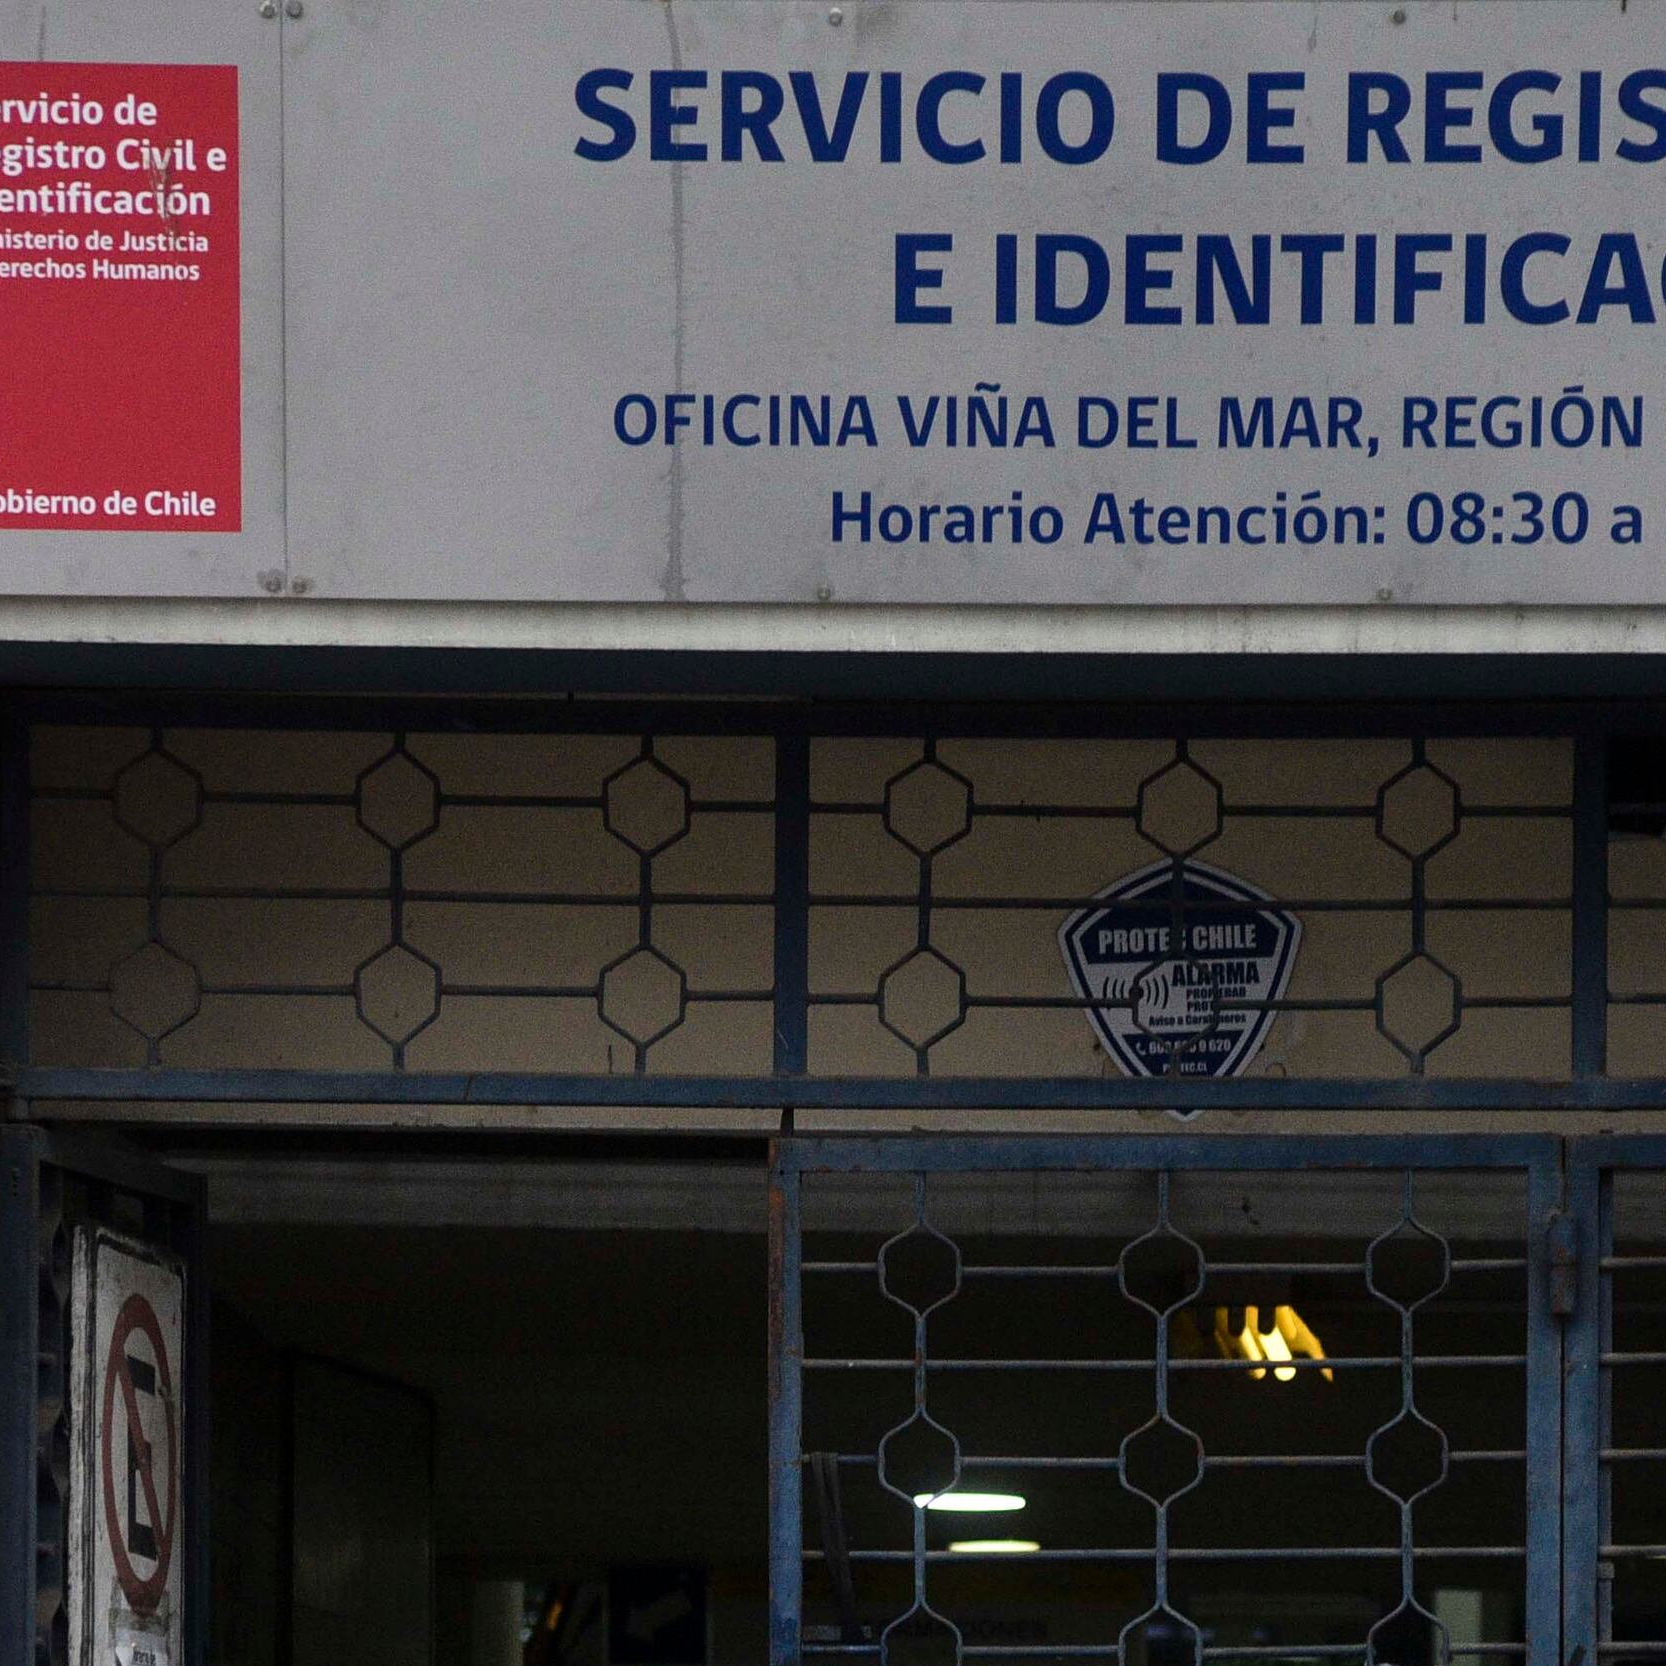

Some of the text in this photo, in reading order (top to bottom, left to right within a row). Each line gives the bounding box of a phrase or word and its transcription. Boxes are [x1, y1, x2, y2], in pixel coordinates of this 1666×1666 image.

[114, 94, 157, 125] de
[574, 69, 1114, 165] SERVICIO
[1157, 72, 1305, 165] DE
[117, 139, 196, 170] Civil
[207, 148, 226, 171] e
[85, 230, 113, 250] de
[120, 231, 208, 252] Justicia
[93, 259, 199, 280] Humanos
[895, 234, 952, 324] E
[614, 394, 878, 446] OFICINA
[897, 382, 1055, 447] VIÑA
[1078, 397, 1197, 448] DEL
[1219, 397, 1378, 457] MAR,
[1403, 386, 1642, 448] REGIÓN
[104, 491, 137, 515] de
[145, 491, 215, 516] Chile
[832, 491, 1063, 544] Horario
[1084, 491, 1384, 544] Atención:
[1407, 492, 1588, 544] 08:30
[1611, 506, 1642, 544] a
[1099, 924, 1256, 954] PROTE CHILE
[1172, 961, 1261, 987] ALARMA
[1186, 987, 1247, 999] PROPEDAD
[1186, 1012, 1246, 1026] Caraneros
